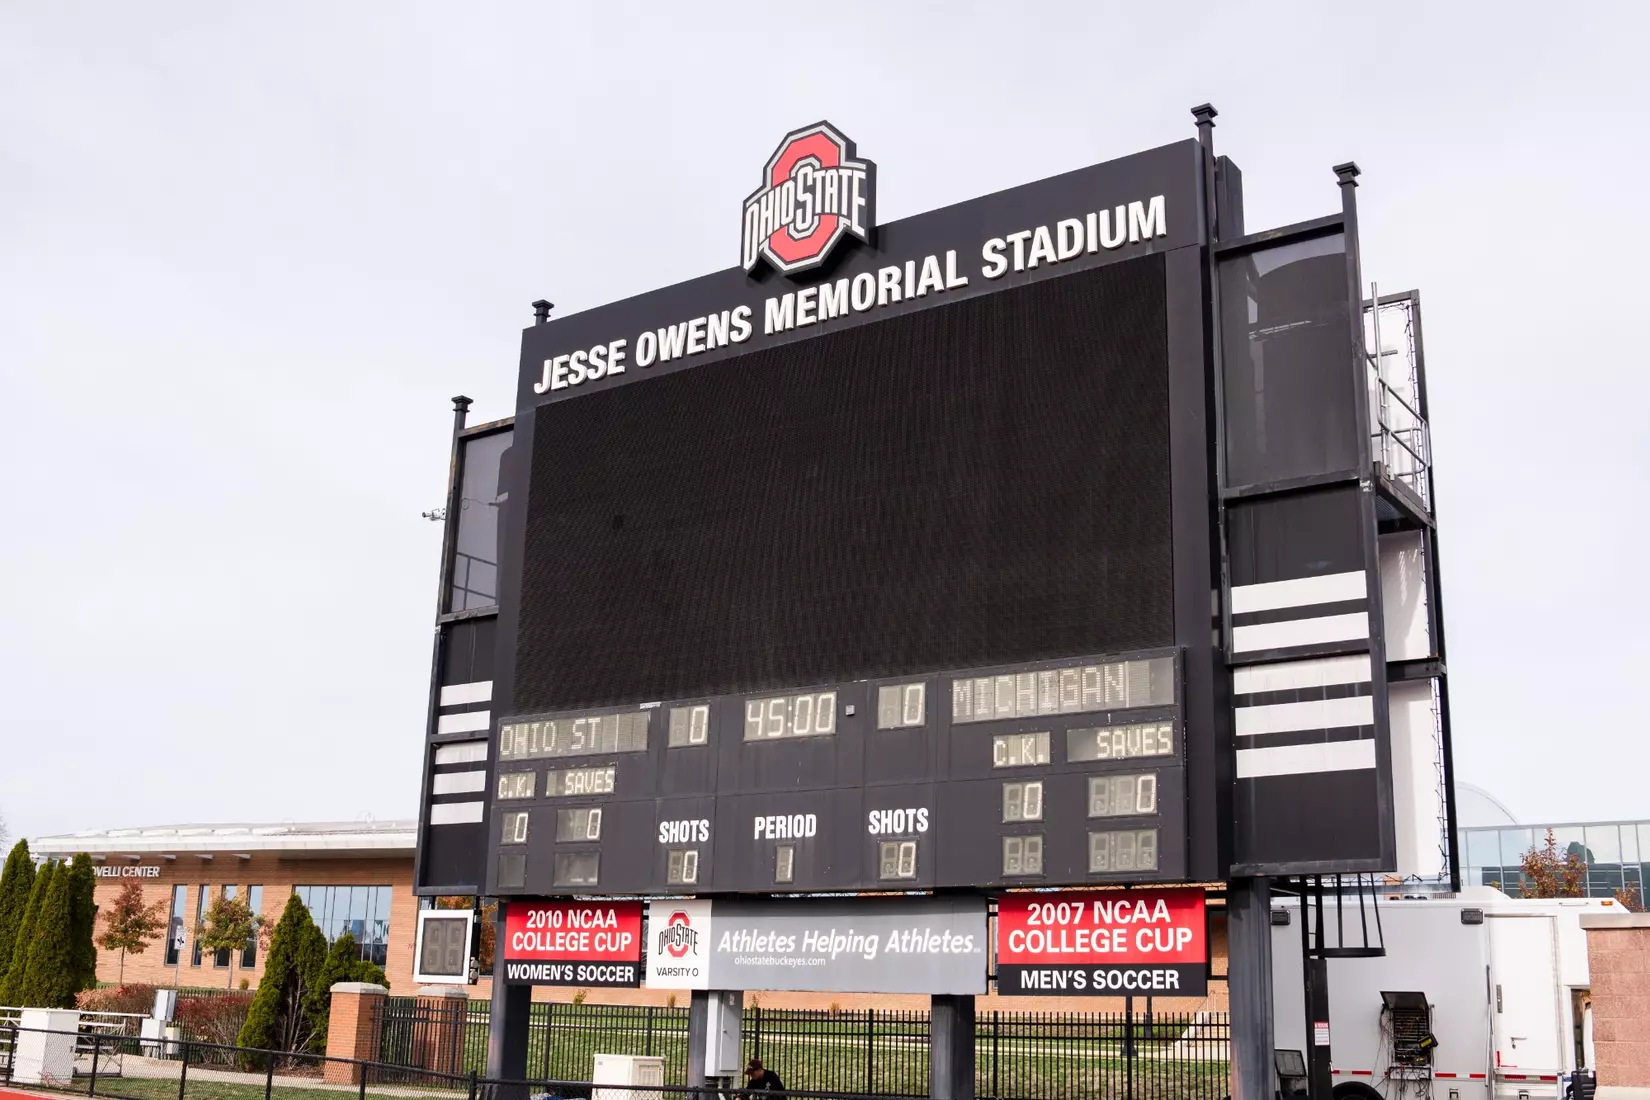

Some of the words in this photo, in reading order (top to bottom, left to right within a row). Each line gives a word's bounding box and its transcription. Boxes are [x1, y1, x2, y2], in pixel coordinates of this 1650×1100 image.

[533, 338, 627, 395] JESSE
[635, 305, 752, 368] OWENS
[763, 249, 968, 336] MEMORIAL
[980, 194, 1167, 280] STADIUM
[952, 663, 1125, 718] MICHIGAN
[747, 692, 835, 736] 45:00
[500, 721, 556, 757] OHIO
[571, 717, 601, 750] ST
[1097, 726, 1173, 758] SAVES
[564, 770, 616, 795] SAVES
[658, 818, 711, 844] SHOTS
[754, 813, 818, 840] PERIOD
[868, 807, 930, 835] SHOTS
[122, 866, 160, 878] CENTER
[526, 909, 563, 929] 2010
[566, 909, 618, 929] NCAA
[1027, 902, 1085, 926] 2007
[1093, 898, 1171, 925] NCAA
[512, 931, 588, 952] COLLEGE
[593, 931, 633, 952] CUP
[717, 928, 797, 953] Athletes
[802, 928, 880, 960] Helping
[884, 927, 974, 953] Athletes
[1008, 928, 1128, 954] COLLEGE
[1135, 927, 1193, 953] CUP
[507, 963, 574, 981] WOMEN'S
[577, 965, 635, 983] SOCCER
[656, 967, 691, 977] VARSITY
[692, 967, 699, 977] O
[734, 956, 826, 968] ohiostatebuckeyes.com
[1020, 970, 1087, 990] MEN'S
[1092, 969, 1180, 990] SOCCER
